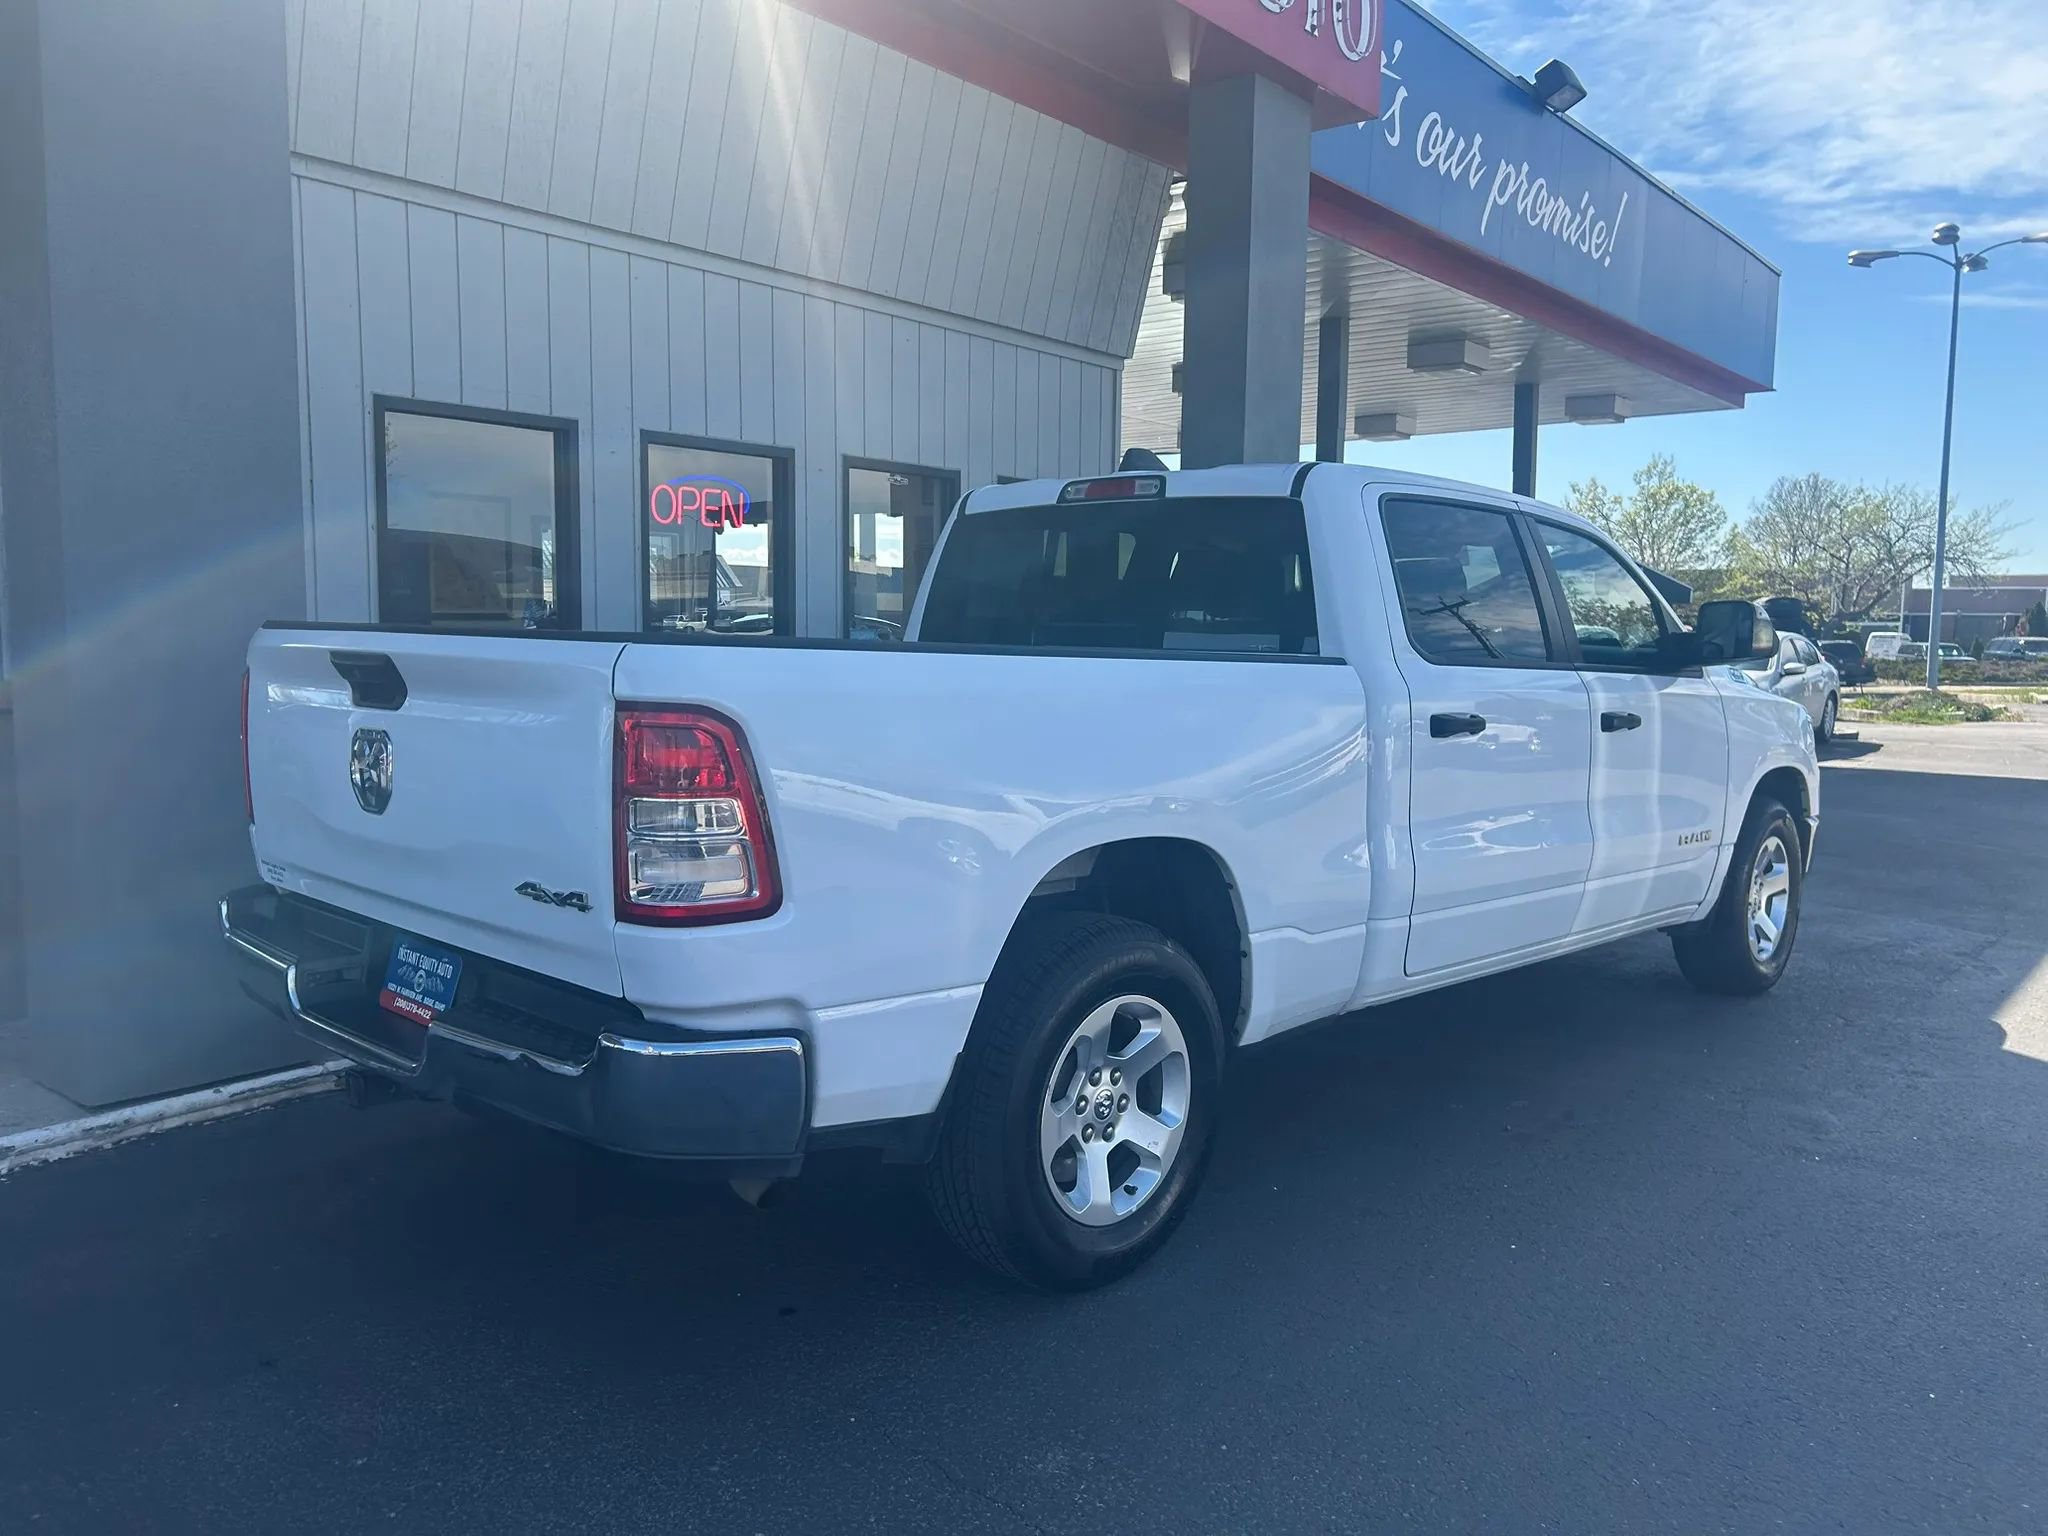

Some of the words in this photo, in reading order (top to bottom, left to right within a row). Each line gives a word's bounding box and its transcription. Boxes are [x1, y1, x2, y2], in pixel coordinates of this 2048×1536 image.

[1416, 112, 1488, 191] our
[1480, 157, 1629, 268] promise!
[651, 483, 744, 529] OPEN
[398, 947, 420, 964] INSTANT
[419, 953, 439, 973] EQUITY
[437, 963, 453, 979] AUTO
